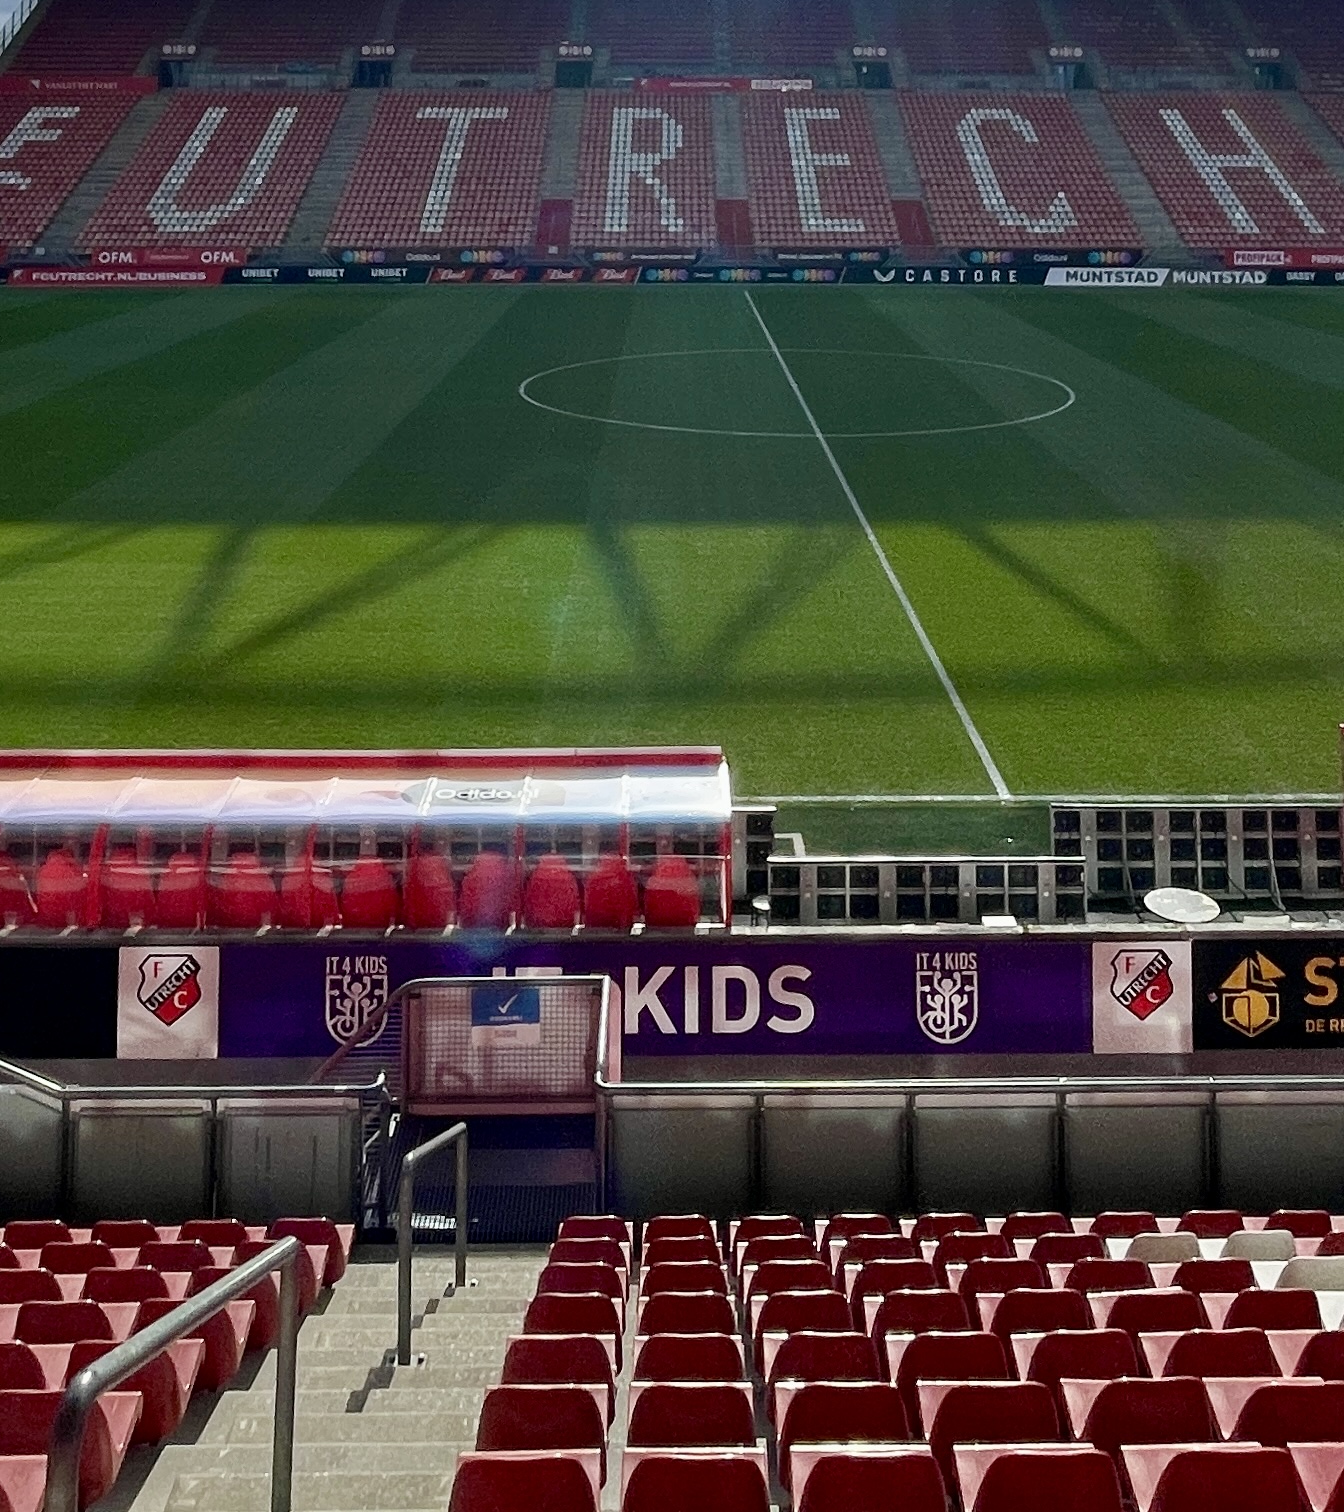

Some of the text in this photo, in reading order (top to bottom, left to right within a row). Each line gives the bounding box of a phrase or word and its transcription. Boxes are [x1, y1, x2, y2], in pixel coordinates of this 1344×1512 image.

[242, 268, 279, 278] UNIBET
[308, 268, 345, 278] UNIBET
[370, 268, 408, 278] UNIBET
[905, 269, 1018, 283] CASTORE
[1065, 270, 1267, 285] MUNTSTAD MUNTSTAD
[153, 961, 164, 978] F
[326, 956, 388, 974] IT 4 KIDS
[916, 952, 978, 970] IT 4 KIDS
[1125, 956, 1136, 974] F
[145, 959, 197, 1011] UTRECHT
[1118, 953, 1168, 1006] UTRECHT
[173, 990, 188, 1009] C
[624, 964, 815, 1034] KIDS
[1145, 986, 1161, 1003] C
[1305, 1018, 1325, 1033] DE
